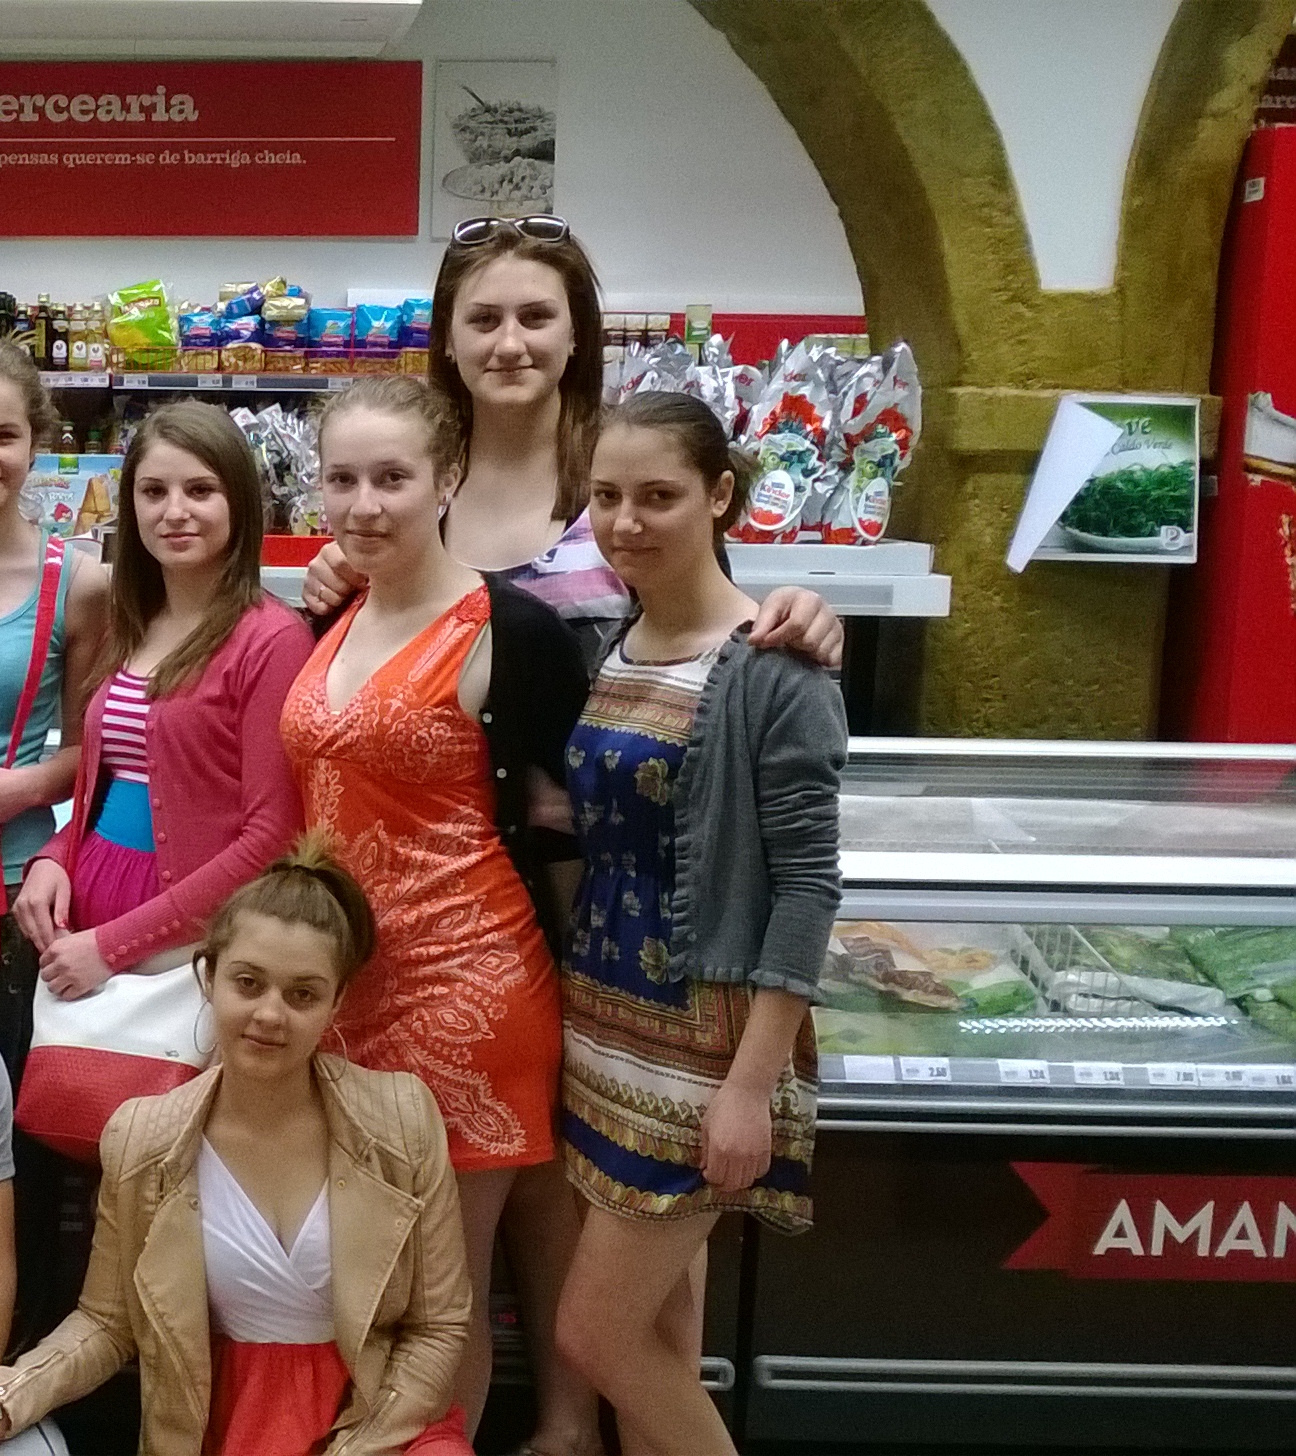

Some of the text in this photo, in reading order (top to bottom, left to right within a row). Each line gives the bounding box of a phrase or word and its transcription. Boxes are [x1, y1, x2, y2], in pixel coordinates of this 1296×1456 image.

[63, 152, 155, 168] querem-se
[159, 150, 180, 164] de
[184, 150, 251, 167] barriga
[255, 150, 306, 164] cheia.
